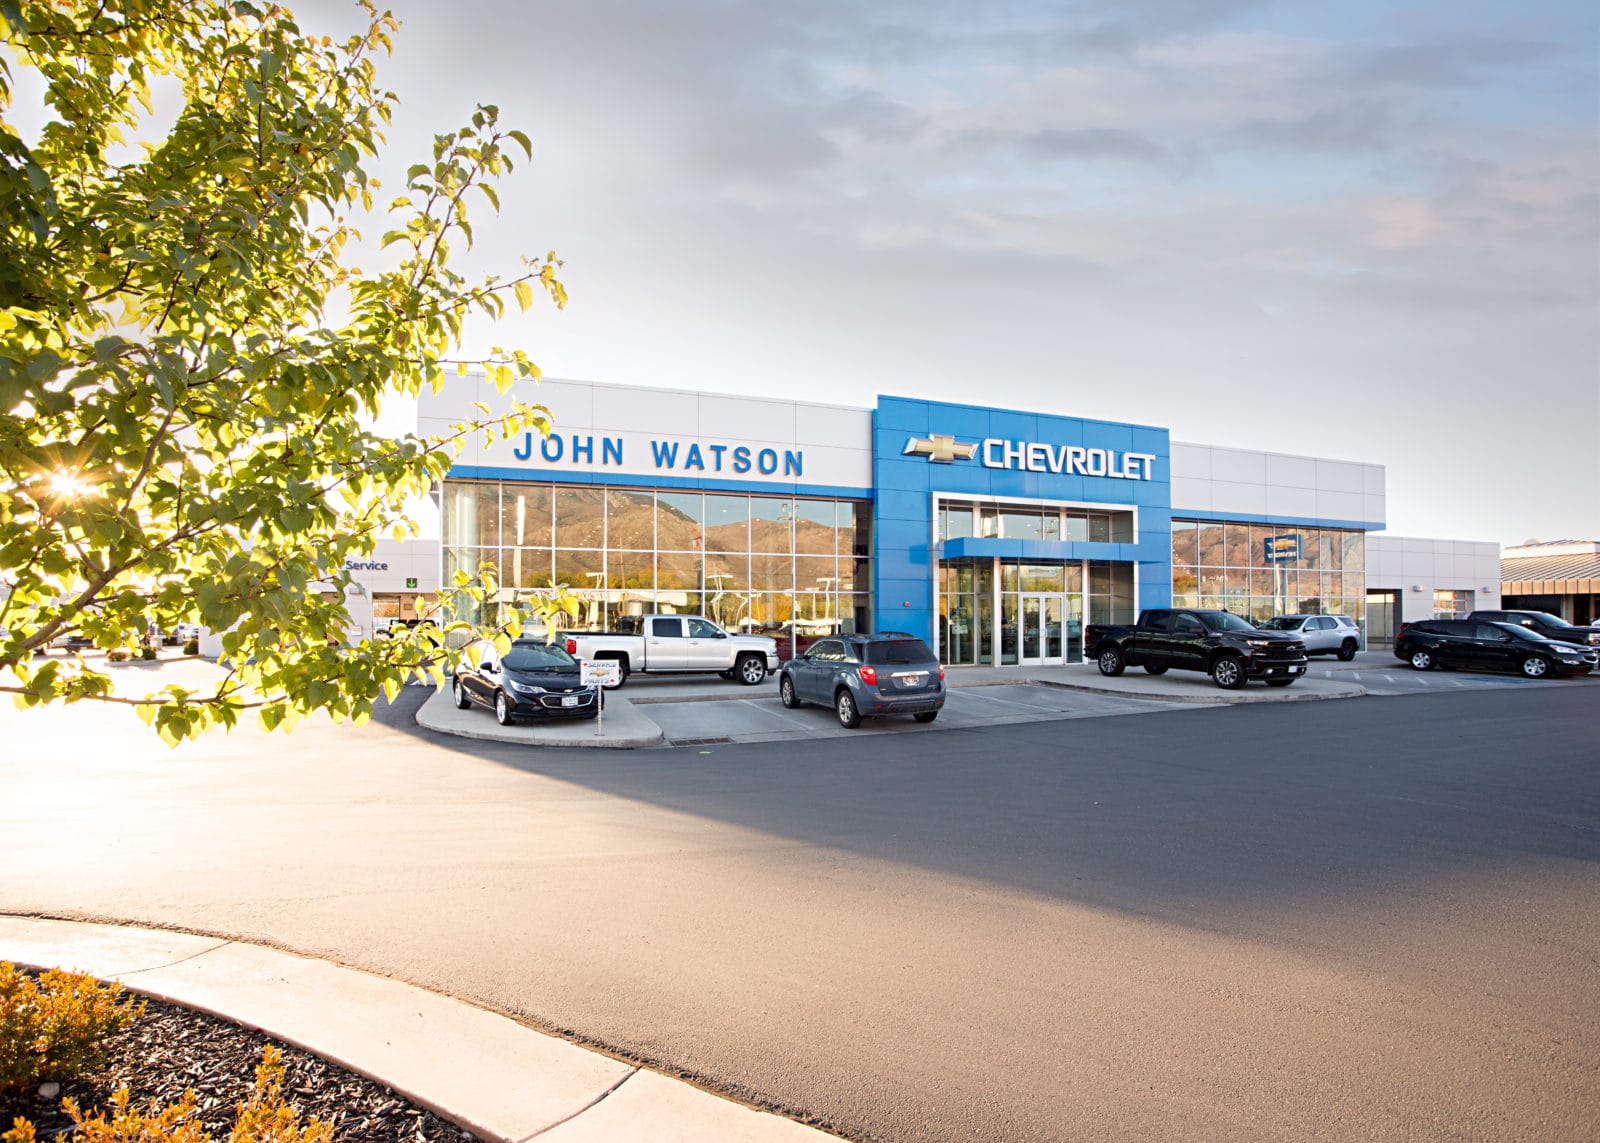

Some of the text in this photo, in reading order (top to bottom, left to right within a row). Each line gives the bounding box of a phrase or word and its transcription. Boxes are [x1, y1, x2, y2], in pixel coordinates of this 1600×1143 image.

[513, 432, 803, 476] JOHN WATSON
[983, 438, 1156, 481] CHEVROLET
[345, 560, 388, 571] Service
